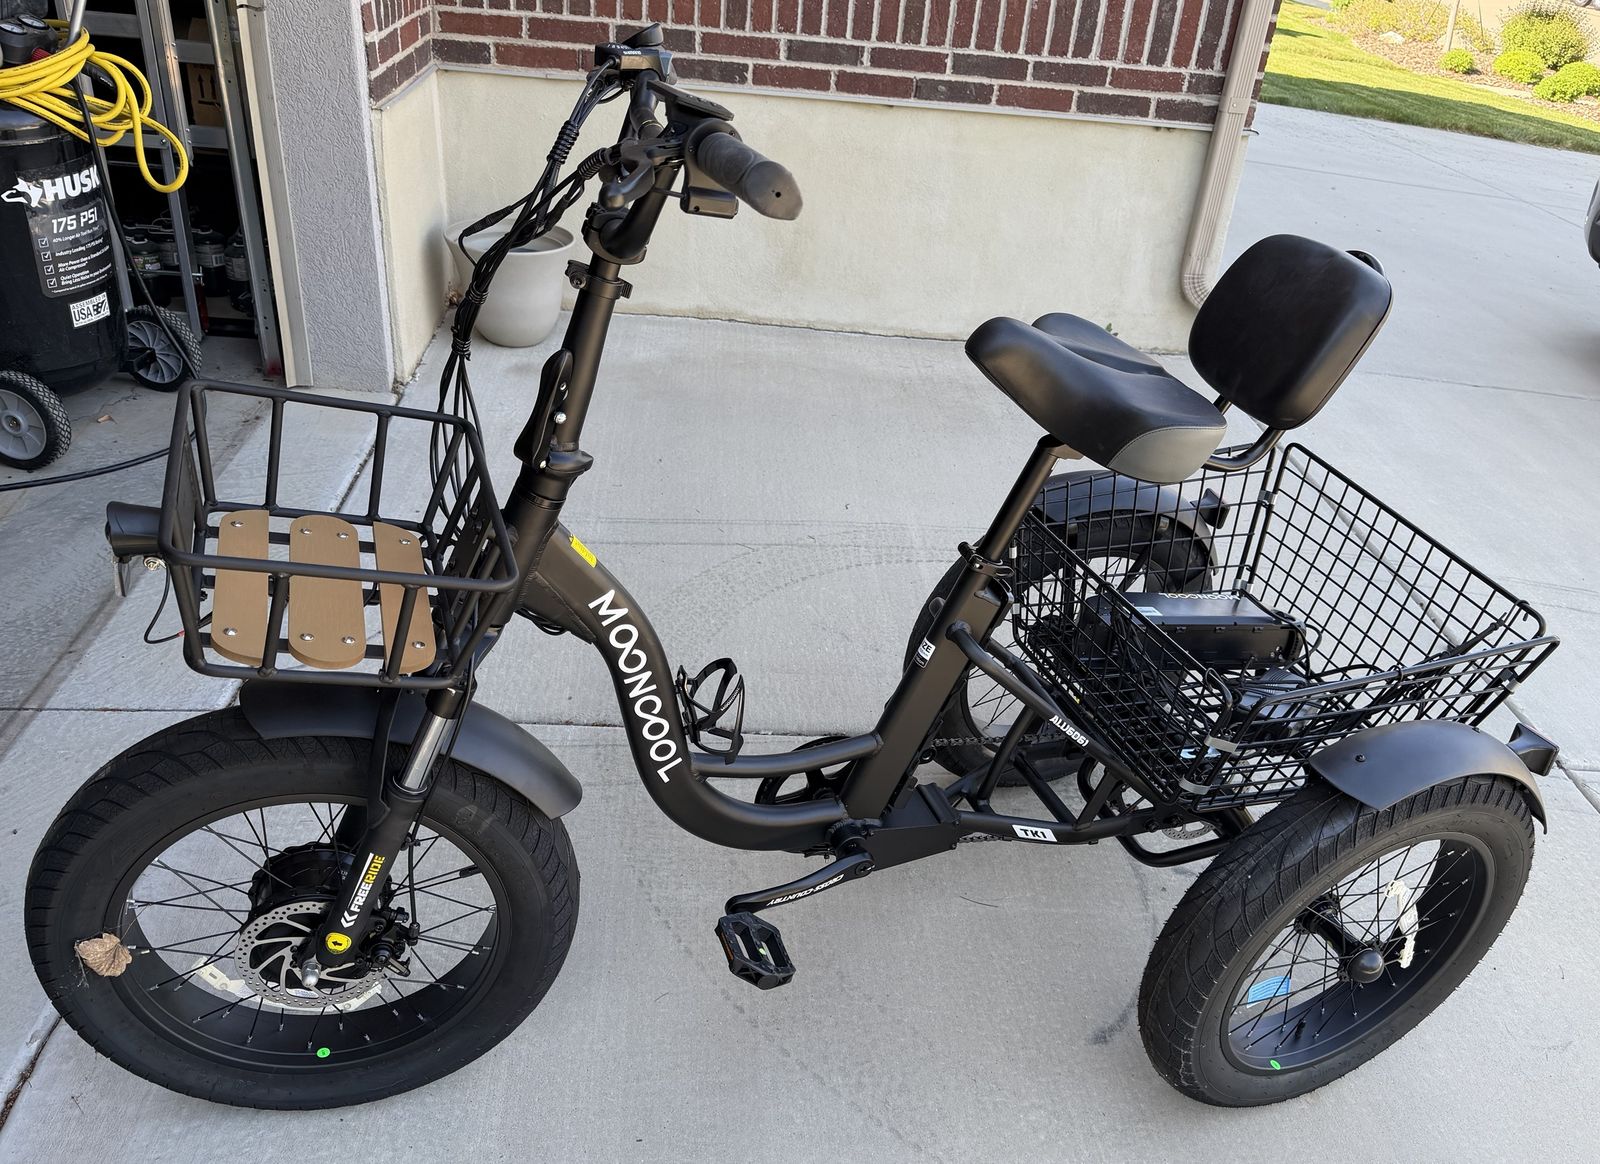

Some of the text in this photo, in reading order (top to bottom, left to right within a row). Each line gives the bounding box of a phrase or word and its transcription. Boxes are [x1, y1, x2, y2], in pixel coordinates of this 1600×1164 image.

[51, 206, 98, 234] 175 PSI
[73, 306, 94, 322] USA
[588, 589, 683, 784] MOONCOOL
[1049, 714, 1090, 747] ALU6061
[1018, 827, 1048, 840] TK1
[350, 855, 386, 913] FREERIDE
